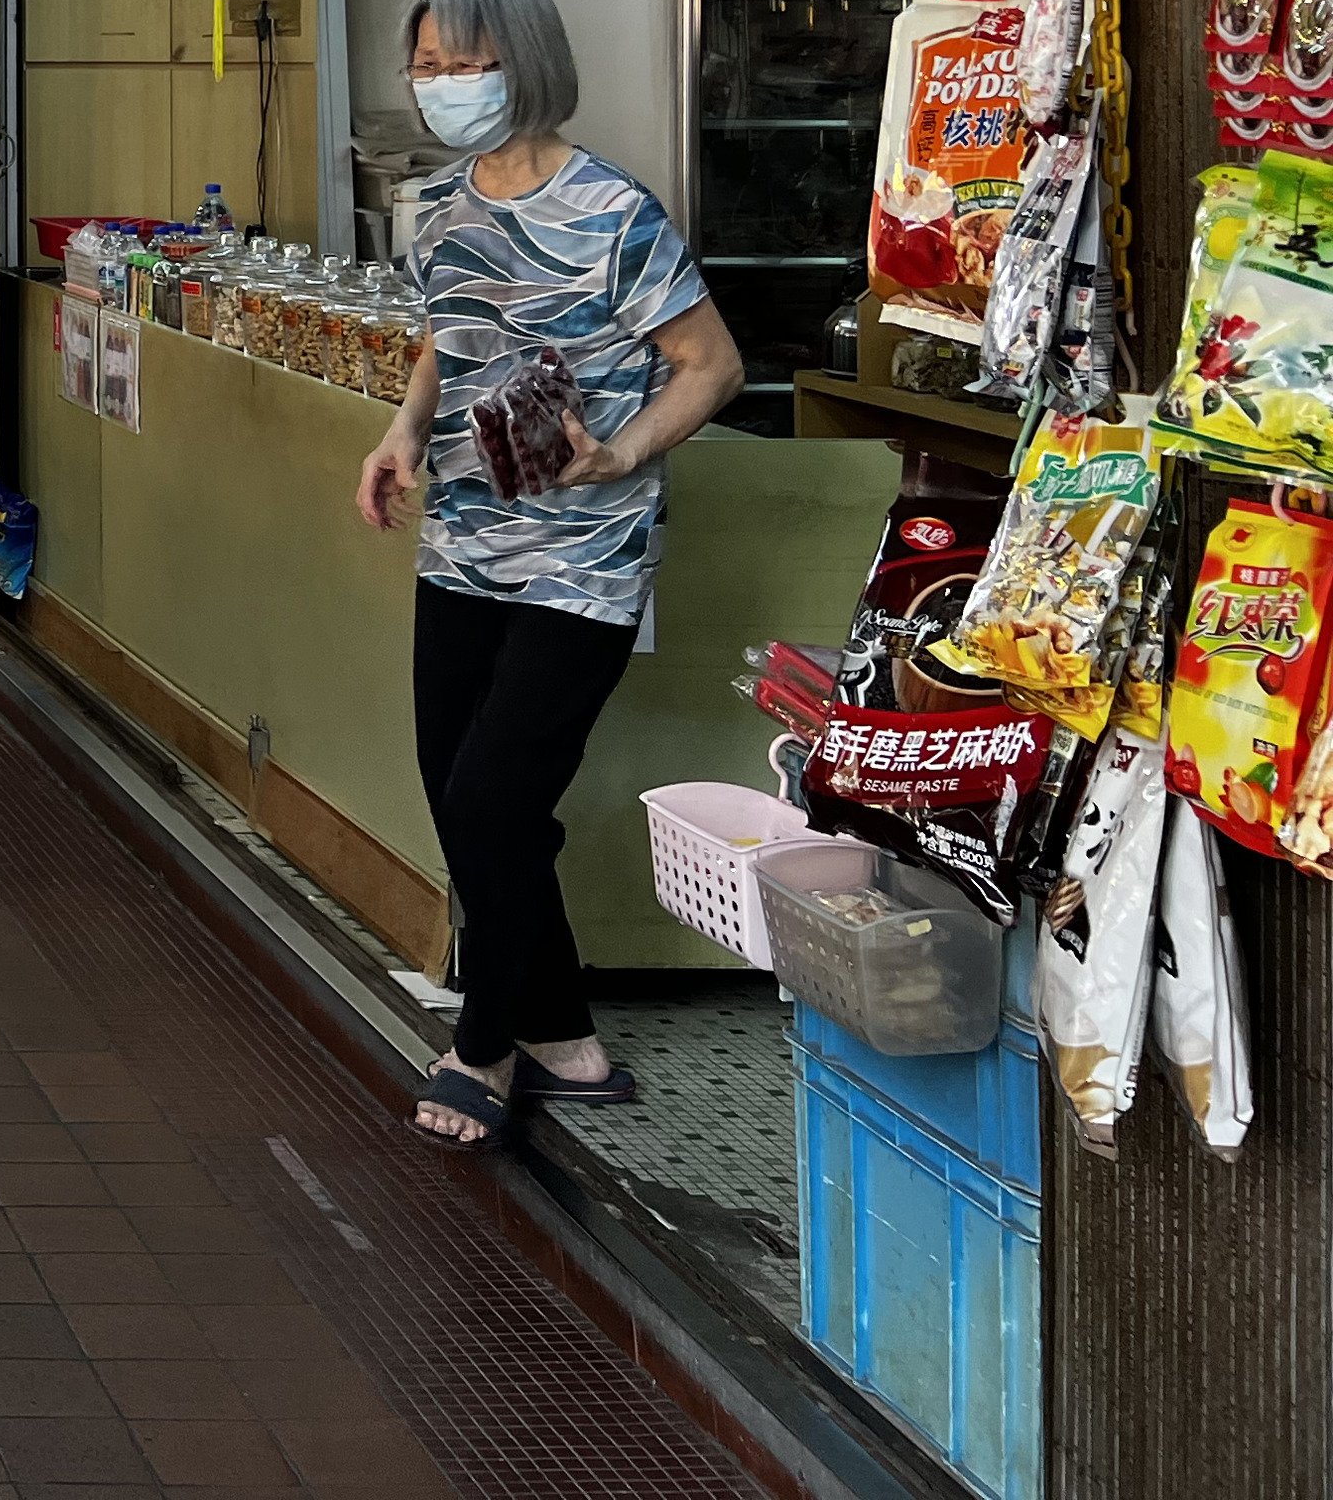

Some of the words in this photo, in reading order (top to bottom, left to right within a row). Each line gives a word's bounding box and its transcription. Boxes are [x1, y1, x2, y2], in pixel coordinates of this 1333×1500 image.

[930, 49, 1020, 81] WALNU
[924, 73, 1021, 105] POWDE
[863, 779, 912, 794] SESAME
[915, 777, 961, 793] PASTE
